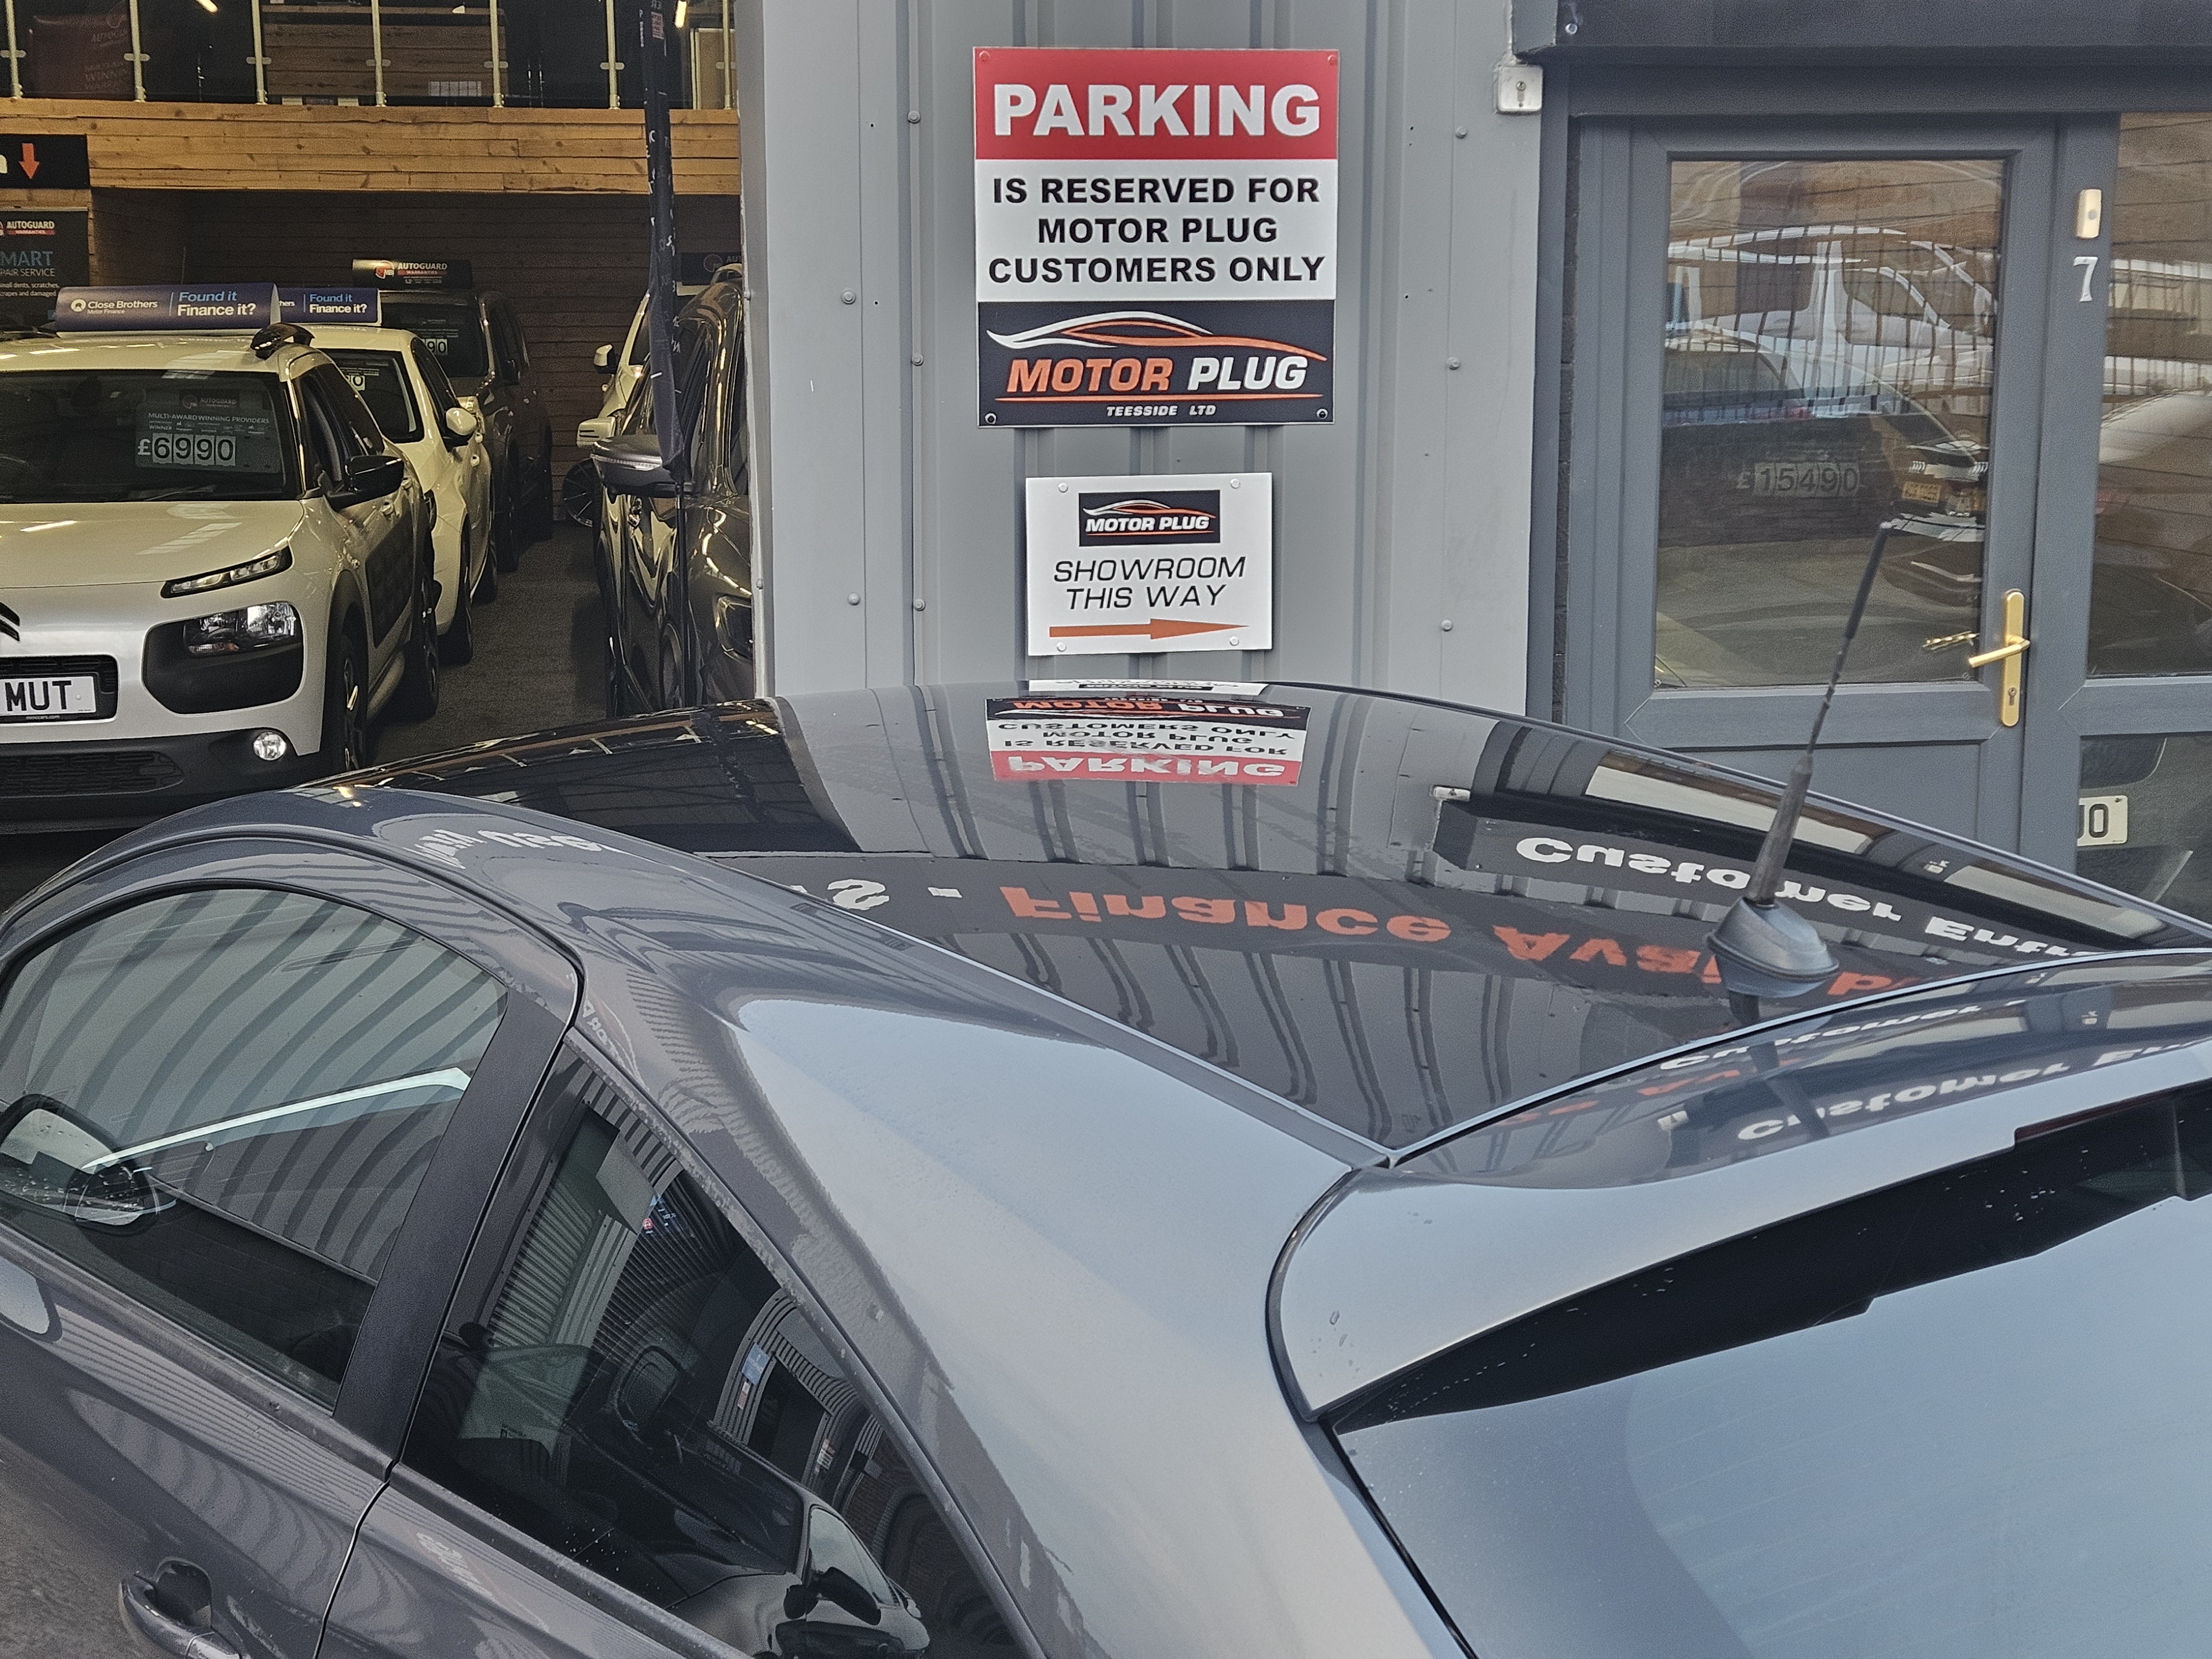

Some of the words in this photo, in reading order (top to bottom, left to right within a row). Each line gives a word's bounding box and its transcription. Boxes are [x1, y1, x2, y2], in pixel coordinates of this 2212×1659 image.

[994, 84, 1320, 137] PARKING
[994, 178, 1027, 204] IS
[1041, 178, 1234, 204] RESERVED
[1248, 177, 1320, 203] FOR
[7, 221, 55, 229] AUTOGUARD
[1039, 218, 1170, 243] MOTOR
[1182, 217, 1278, 242] PLUG
[20, 268, 55, 276] SERVICE
[989, 257, 1216, 283] CUSTOMERS
[1228, 256, 1326, 282] ONLY
[2074, 256, 2098, 302] 7
[87, 300, 114, 310] Close
[116, 300, 158, 309] Brothers
[179, 291, 225, 302] Found
[227, 291, 237, 301] it
[310, 294, 343, 302] Found
[345, 294, 353, 302] it
[177, 305, 234, 316] Finance
[237, 303, 257, 315] it?
[310, 305, 352, 314] Finance
[353, 304, 368, 314] it?
[1006, 357, 1173, 393] MOTOR
[1187, 356, 1308, 390] PLUG
[1107, 405, 1178, 416] TEESSIDE
[1188, 405, 1216, 415] LTD
[138, 437, 233, 461] £6990
[1736, 467, 1858, 492] £15490
[1086, 518, 1155, 533] MOTOR
[1159, 516, 1210, 531] PLUG
[1053, 556, 1246, 582] SHOWROOM
[1066, 587, 1133, 610] THIS
[1147, 585, 1227, 608] WAY
[5, 680, 72, 712] MUT
